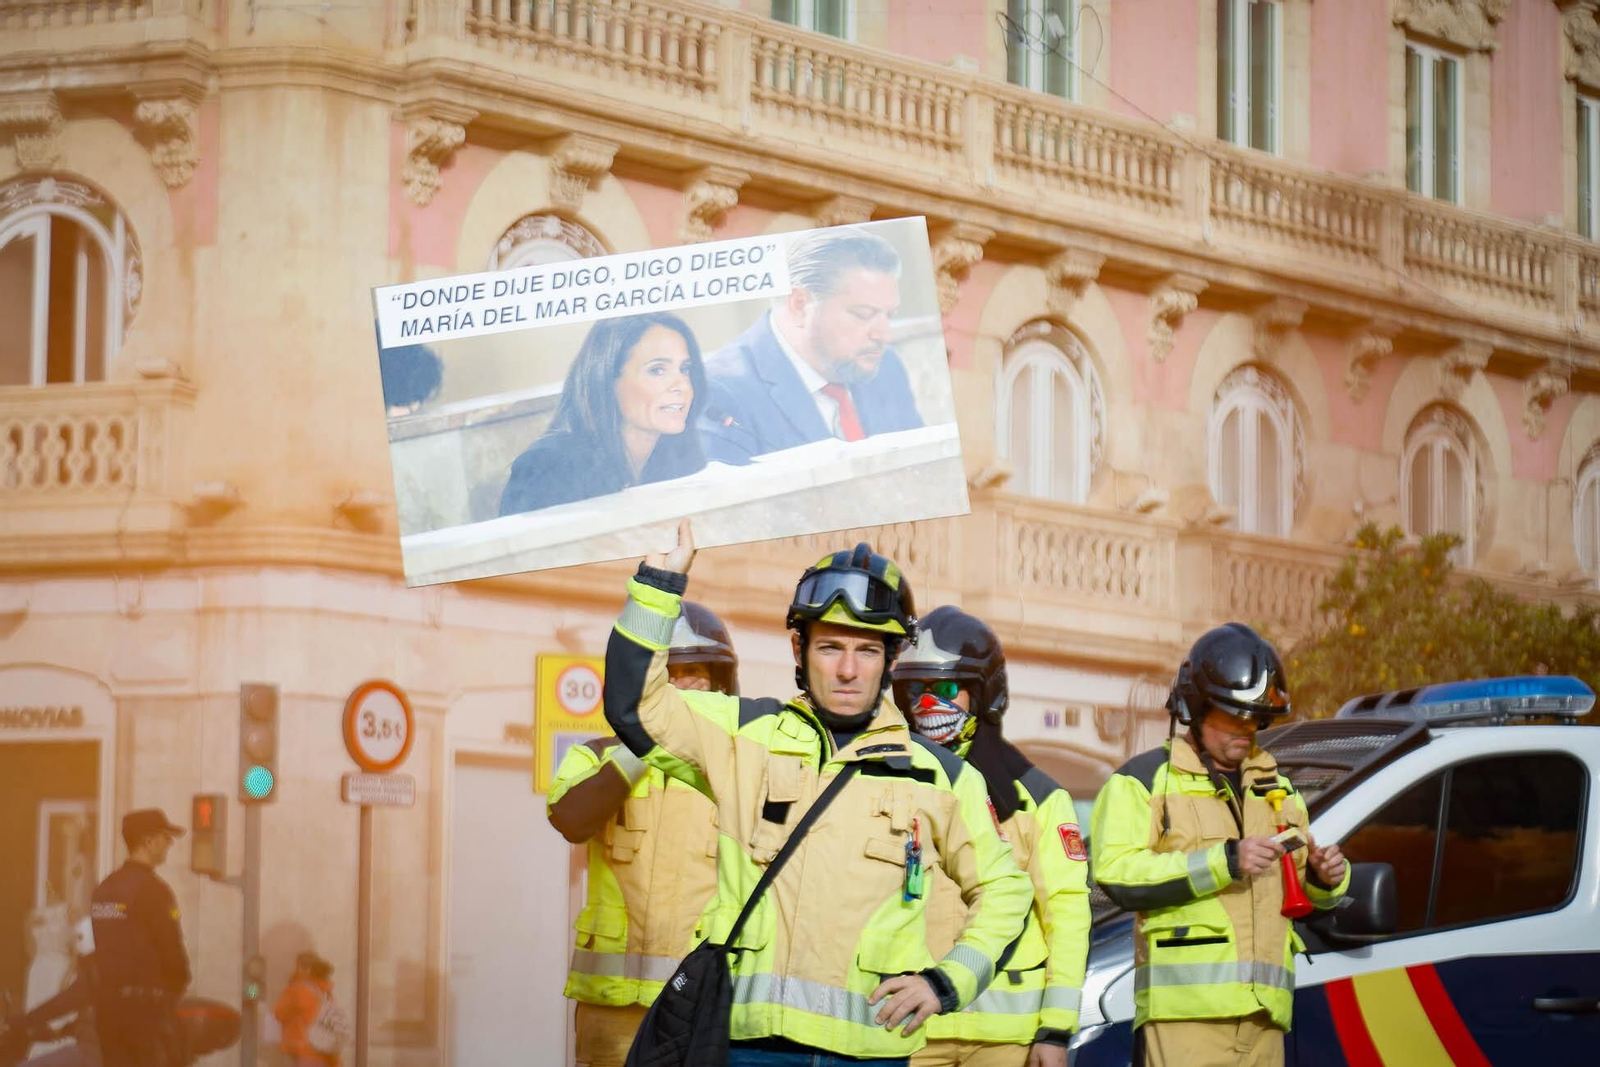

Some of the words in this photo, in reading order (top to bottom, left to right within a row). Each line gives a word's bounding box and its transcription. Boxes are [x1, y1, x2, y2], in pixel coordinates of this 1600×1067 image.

[391, 282, 486, 310] “DONDE
[493, 274, 545, 298] DIJE
[552, 266, 616, 290] DIGO,
[624, 256, 682, 280] DIGO
[691, 244, 776, 272] DIEGO”
[400, 308, 475, 338] MARÍA
[483, 305, 528, 326] DEL
[535, 296, 587, 319] MAR
[595, 280, 685, 311] GARCÍA
[693, 272, 775, 299] LORCA
[565, 680, 596, 700] 30
